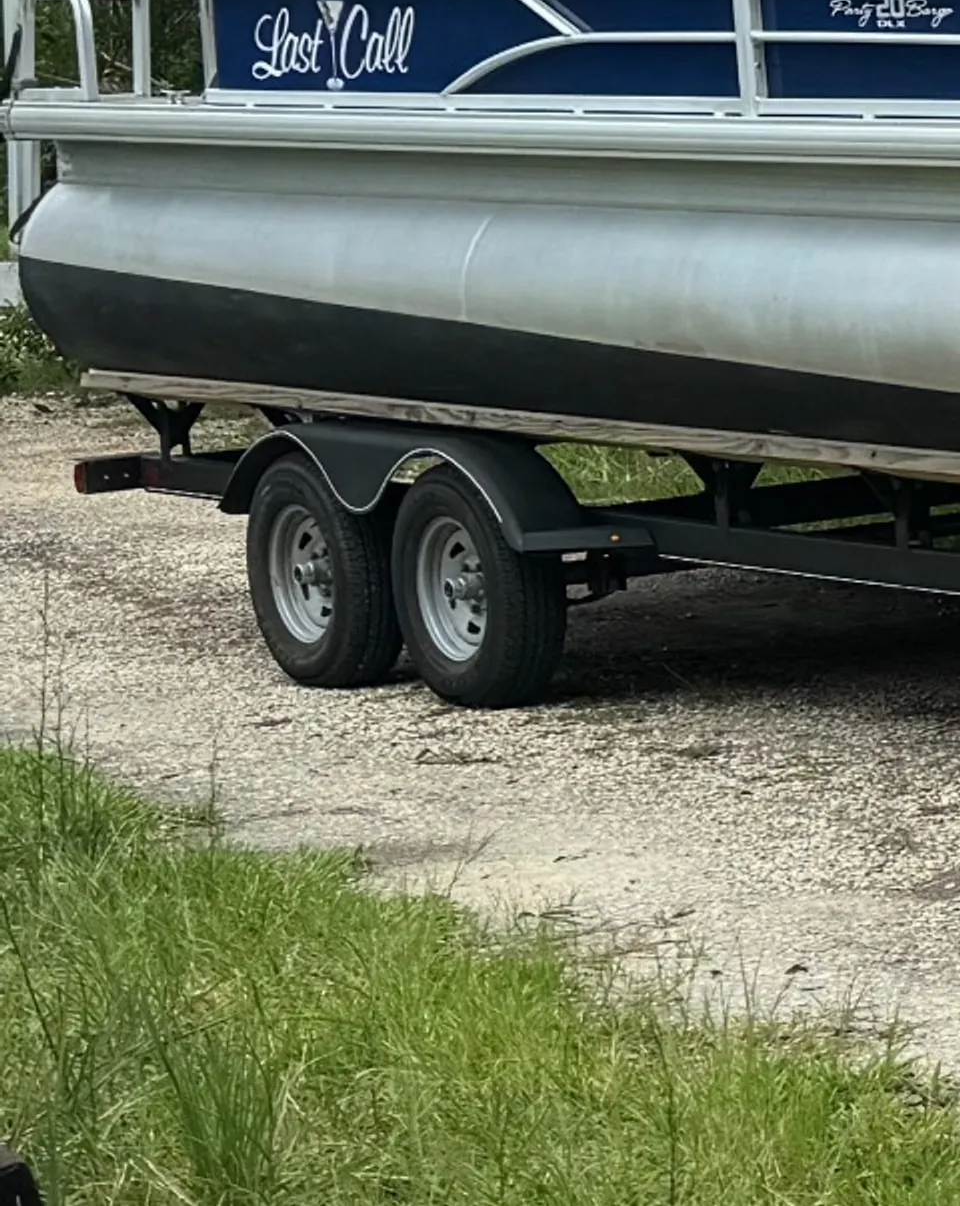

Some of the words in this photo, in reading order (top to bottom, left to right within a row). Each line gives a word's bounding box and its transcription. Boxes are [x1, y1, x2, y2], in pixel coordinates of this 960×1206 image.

[252, 7, 325, 80] Last
[340, 4, 414, 79] Call
[876, 18, 906, 28] DLX
